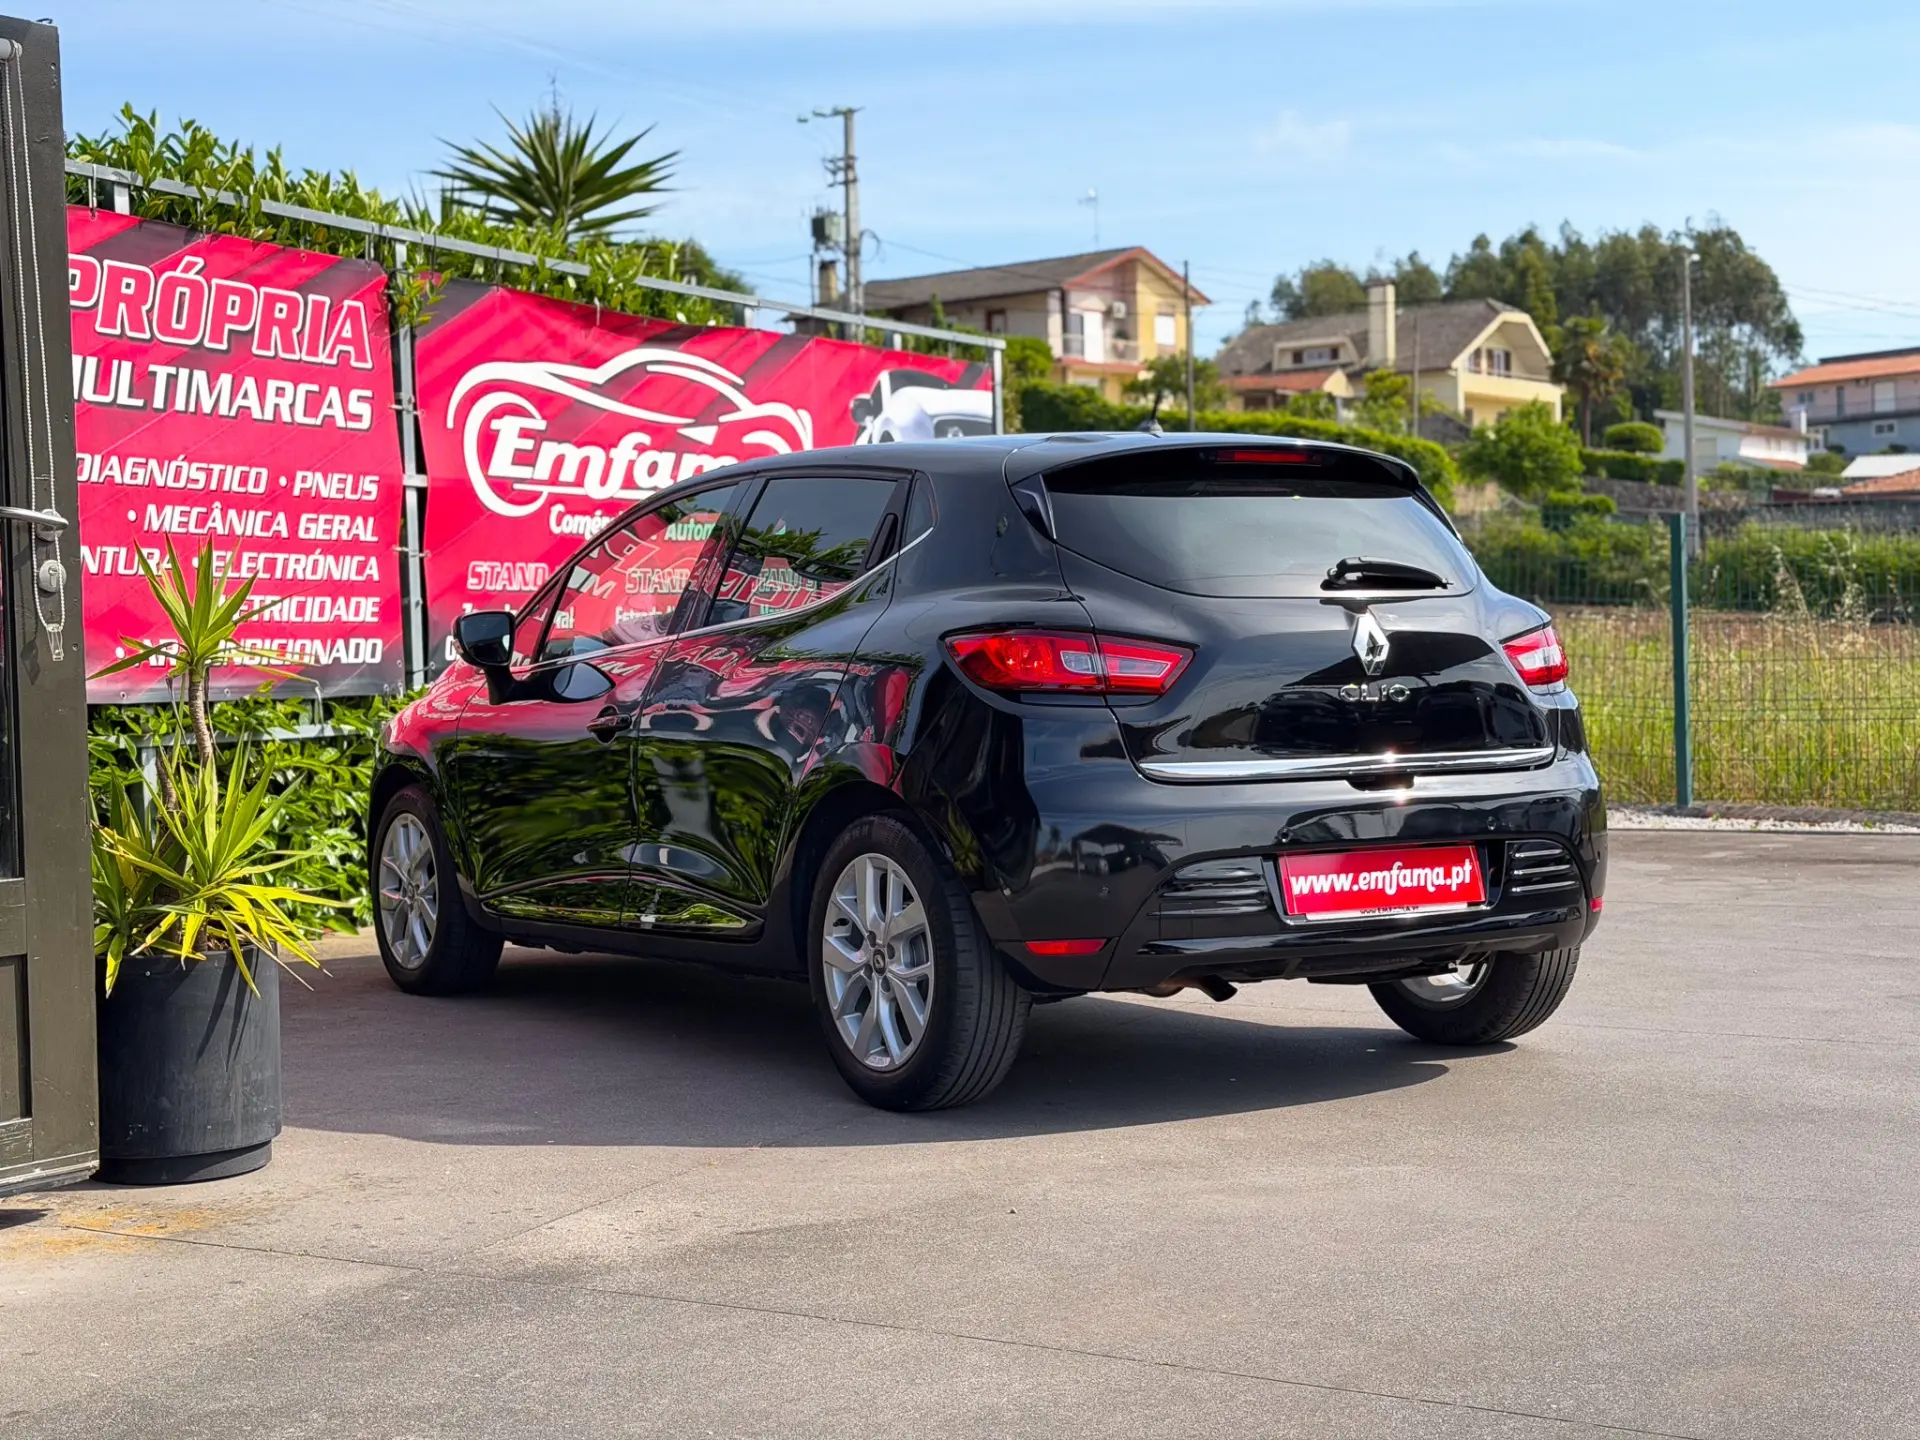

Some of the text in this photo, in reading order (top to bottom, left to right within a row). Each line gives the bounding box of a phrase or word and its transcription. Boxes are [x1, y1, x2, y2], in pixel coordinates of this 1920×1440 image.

[72, 355, 373, 431] ULTIMARCAS
[76, 453, 380, 501] DIAGNÓSTICO PNEUS
[143, 501, 379, 542] MECÂNICA GERAL
[213, 549, 380, 581] ELECTRÓNICA
[1339, 683, 1411, 702] CLIO
[1290, 859, 1473, 895] www.emfama.pt
